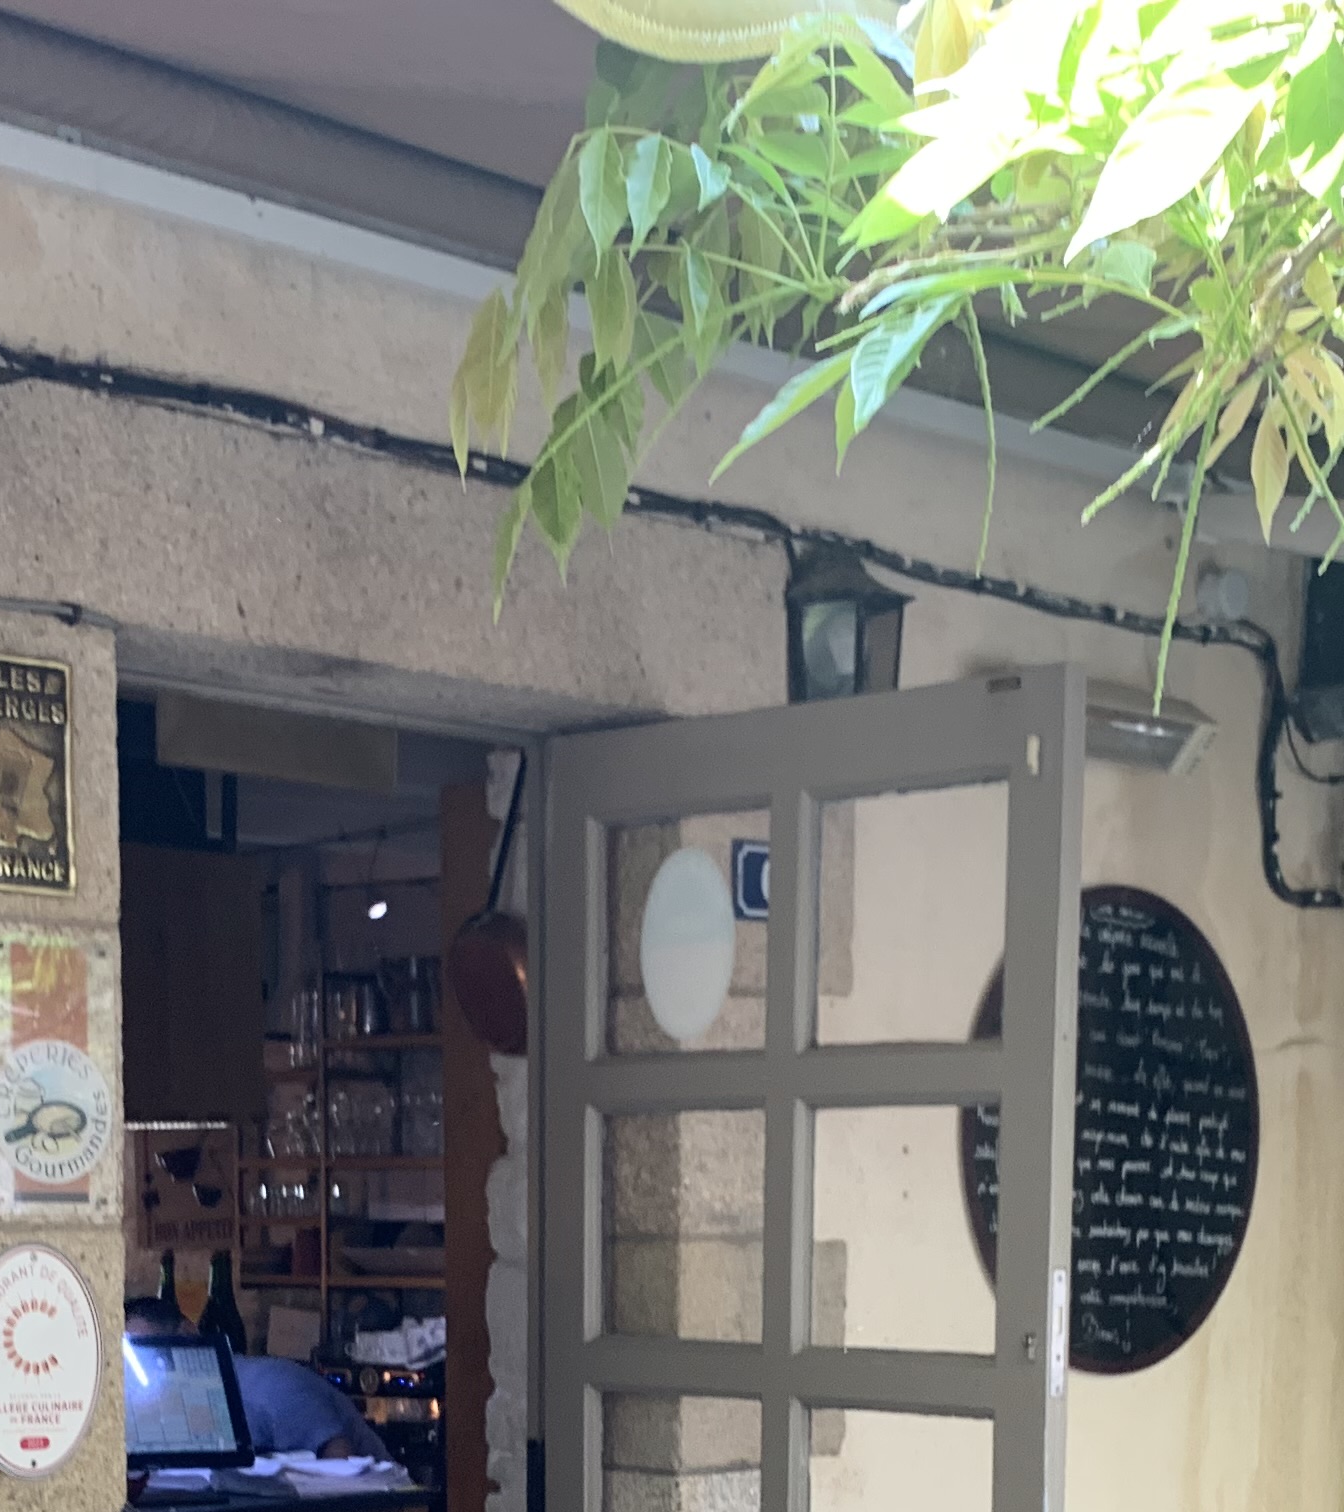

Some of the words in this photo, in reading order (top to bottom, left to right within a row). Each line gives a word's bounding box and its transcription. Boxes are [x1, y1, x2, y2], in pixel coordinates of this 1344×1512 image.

[15, 1089, 108, 1179] Gourmandes
[31, 1400, 85, 1413] CULINAIRE
[21, 1413, 61, 1425] FRANCE
